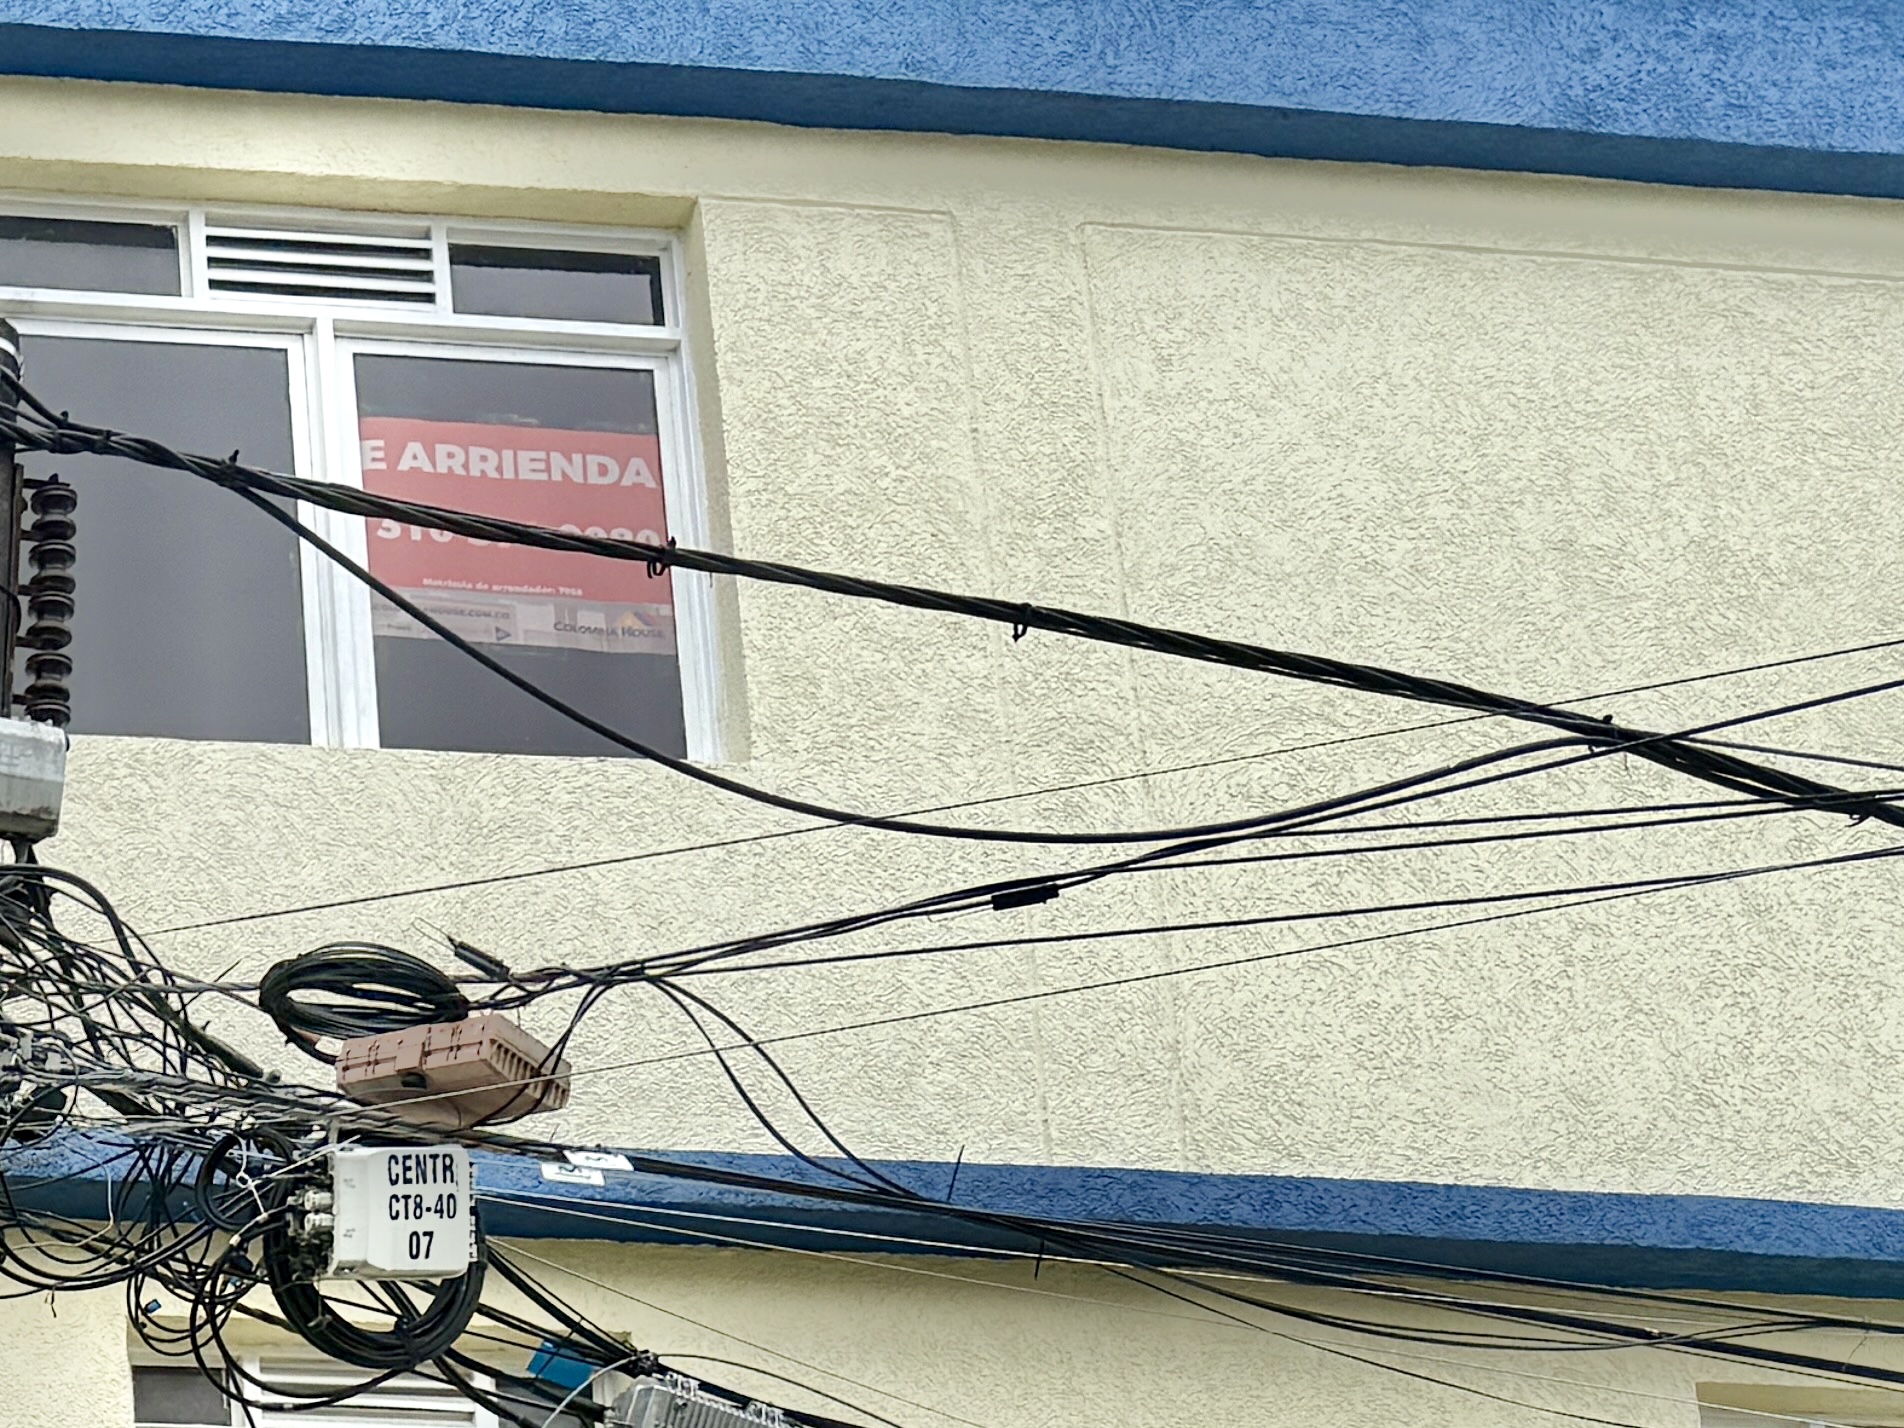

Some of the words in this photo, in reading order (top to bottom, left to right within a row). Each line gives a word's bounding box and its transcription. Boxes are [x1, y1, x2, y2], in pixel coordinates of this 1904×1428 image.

[397, 441, 657, 488] ARRIENDA
[388, 1153, 454, 1186] CENTR
[389, 1193, 457, 1221] CT8-40
[409, 1230, 434, 1260] 07
